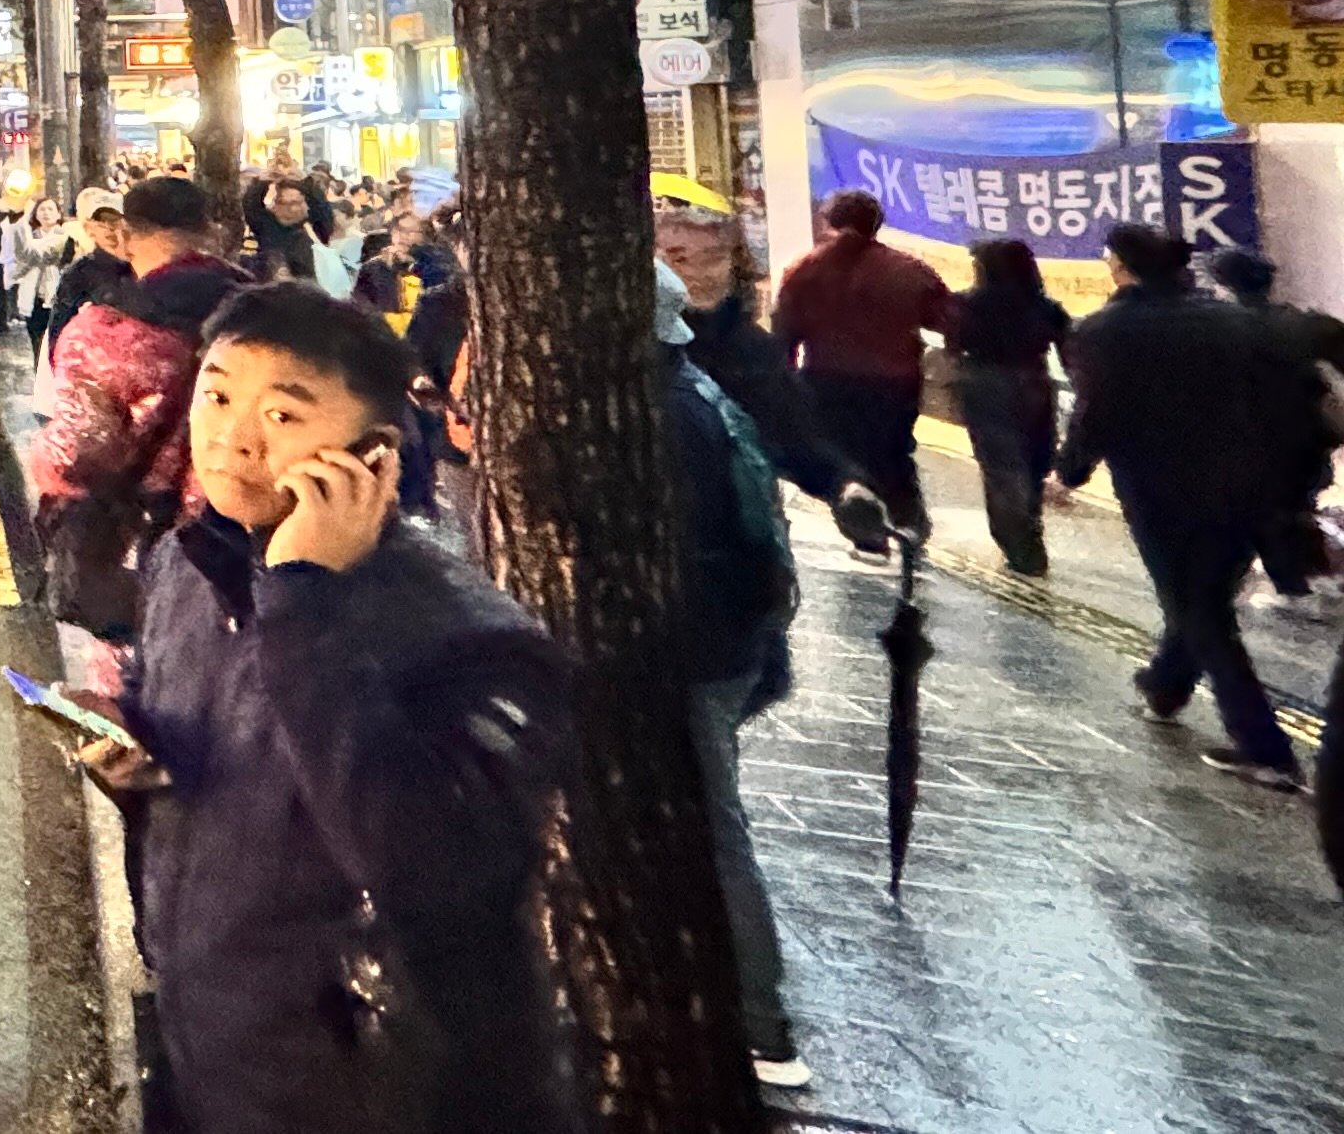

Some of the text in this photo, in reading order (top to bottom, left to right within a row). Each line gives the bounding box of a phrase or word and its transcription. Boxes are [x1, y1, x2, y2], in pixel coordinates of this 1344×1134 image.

[659, 12, 700, 33] 보석
[661, 52, 702, 72] 헤어
[1251, 33, 1344, 78] 명동
[276, 72, 302, 96] 약
[857, 148, 913, 214] SK
[914, 163, 1010, 233] 텔레콤
[1180, 155, 1233, 247] SK
